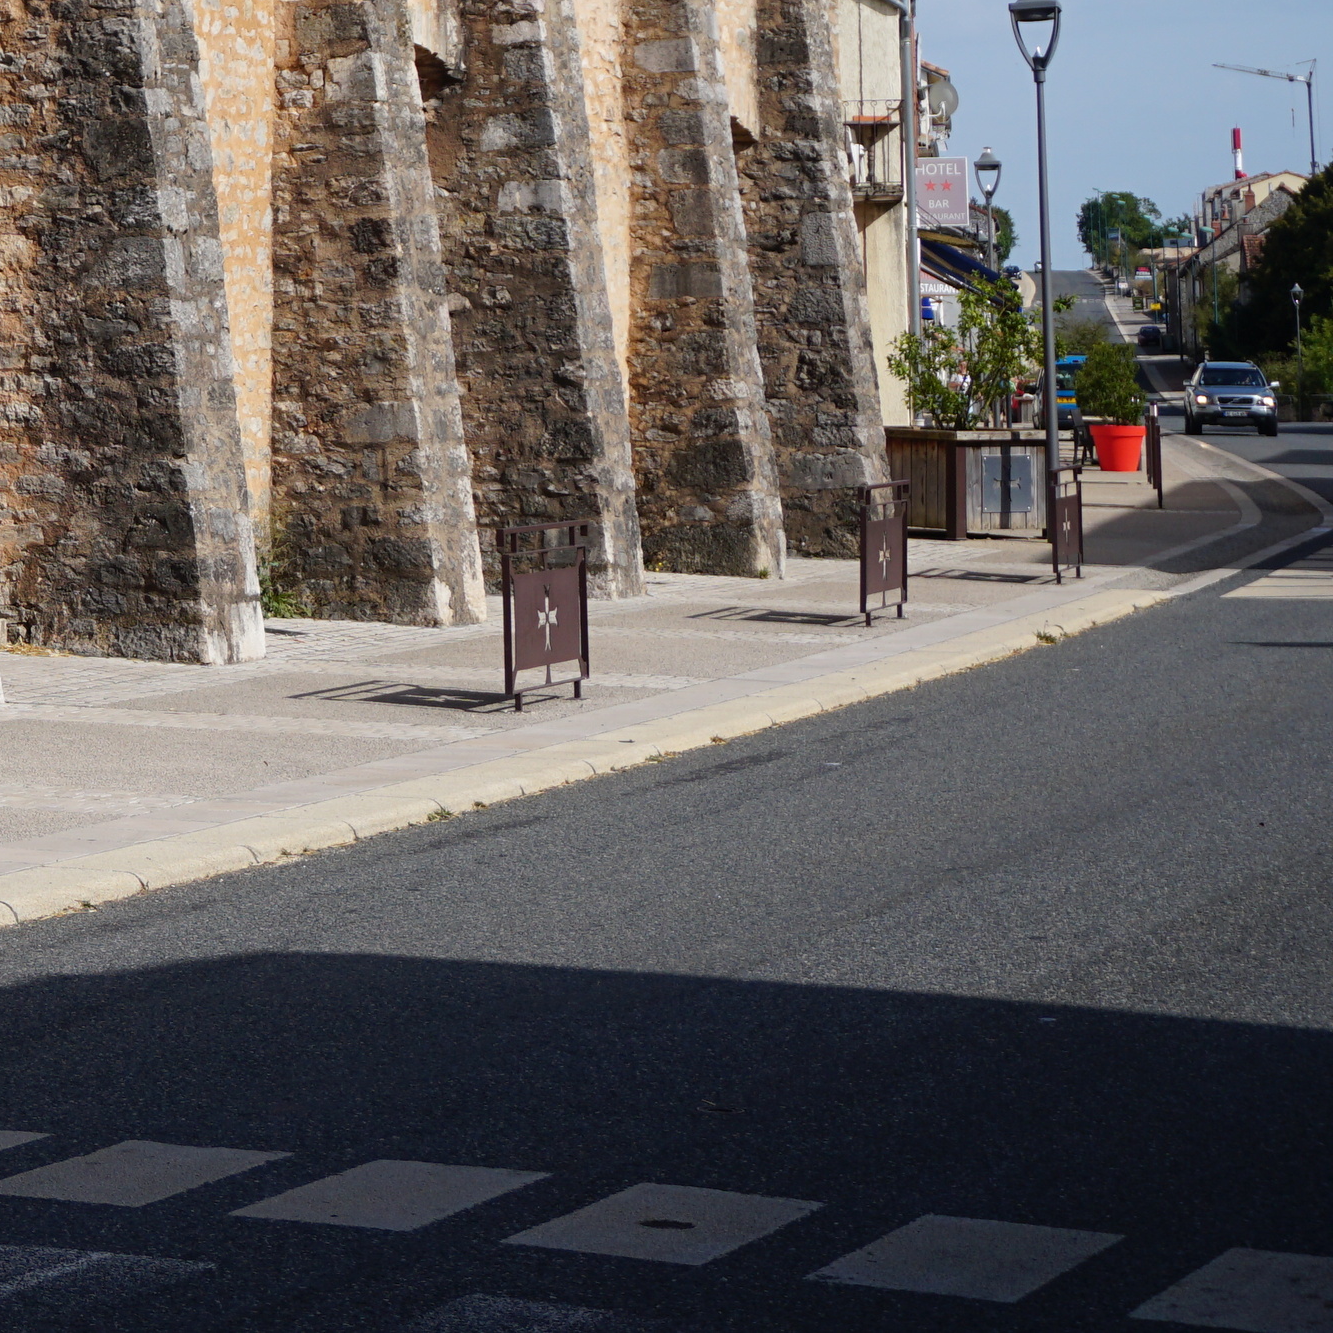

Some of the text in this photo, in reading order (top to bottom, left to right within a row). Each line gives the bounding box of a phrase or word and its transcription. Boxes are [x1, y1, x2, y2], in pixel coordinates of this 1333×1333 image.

[915, 163, 961, 176] HOTEL
[928, 199, 950, 209] BAR
[920, 212, 965, 221] STAURANT
